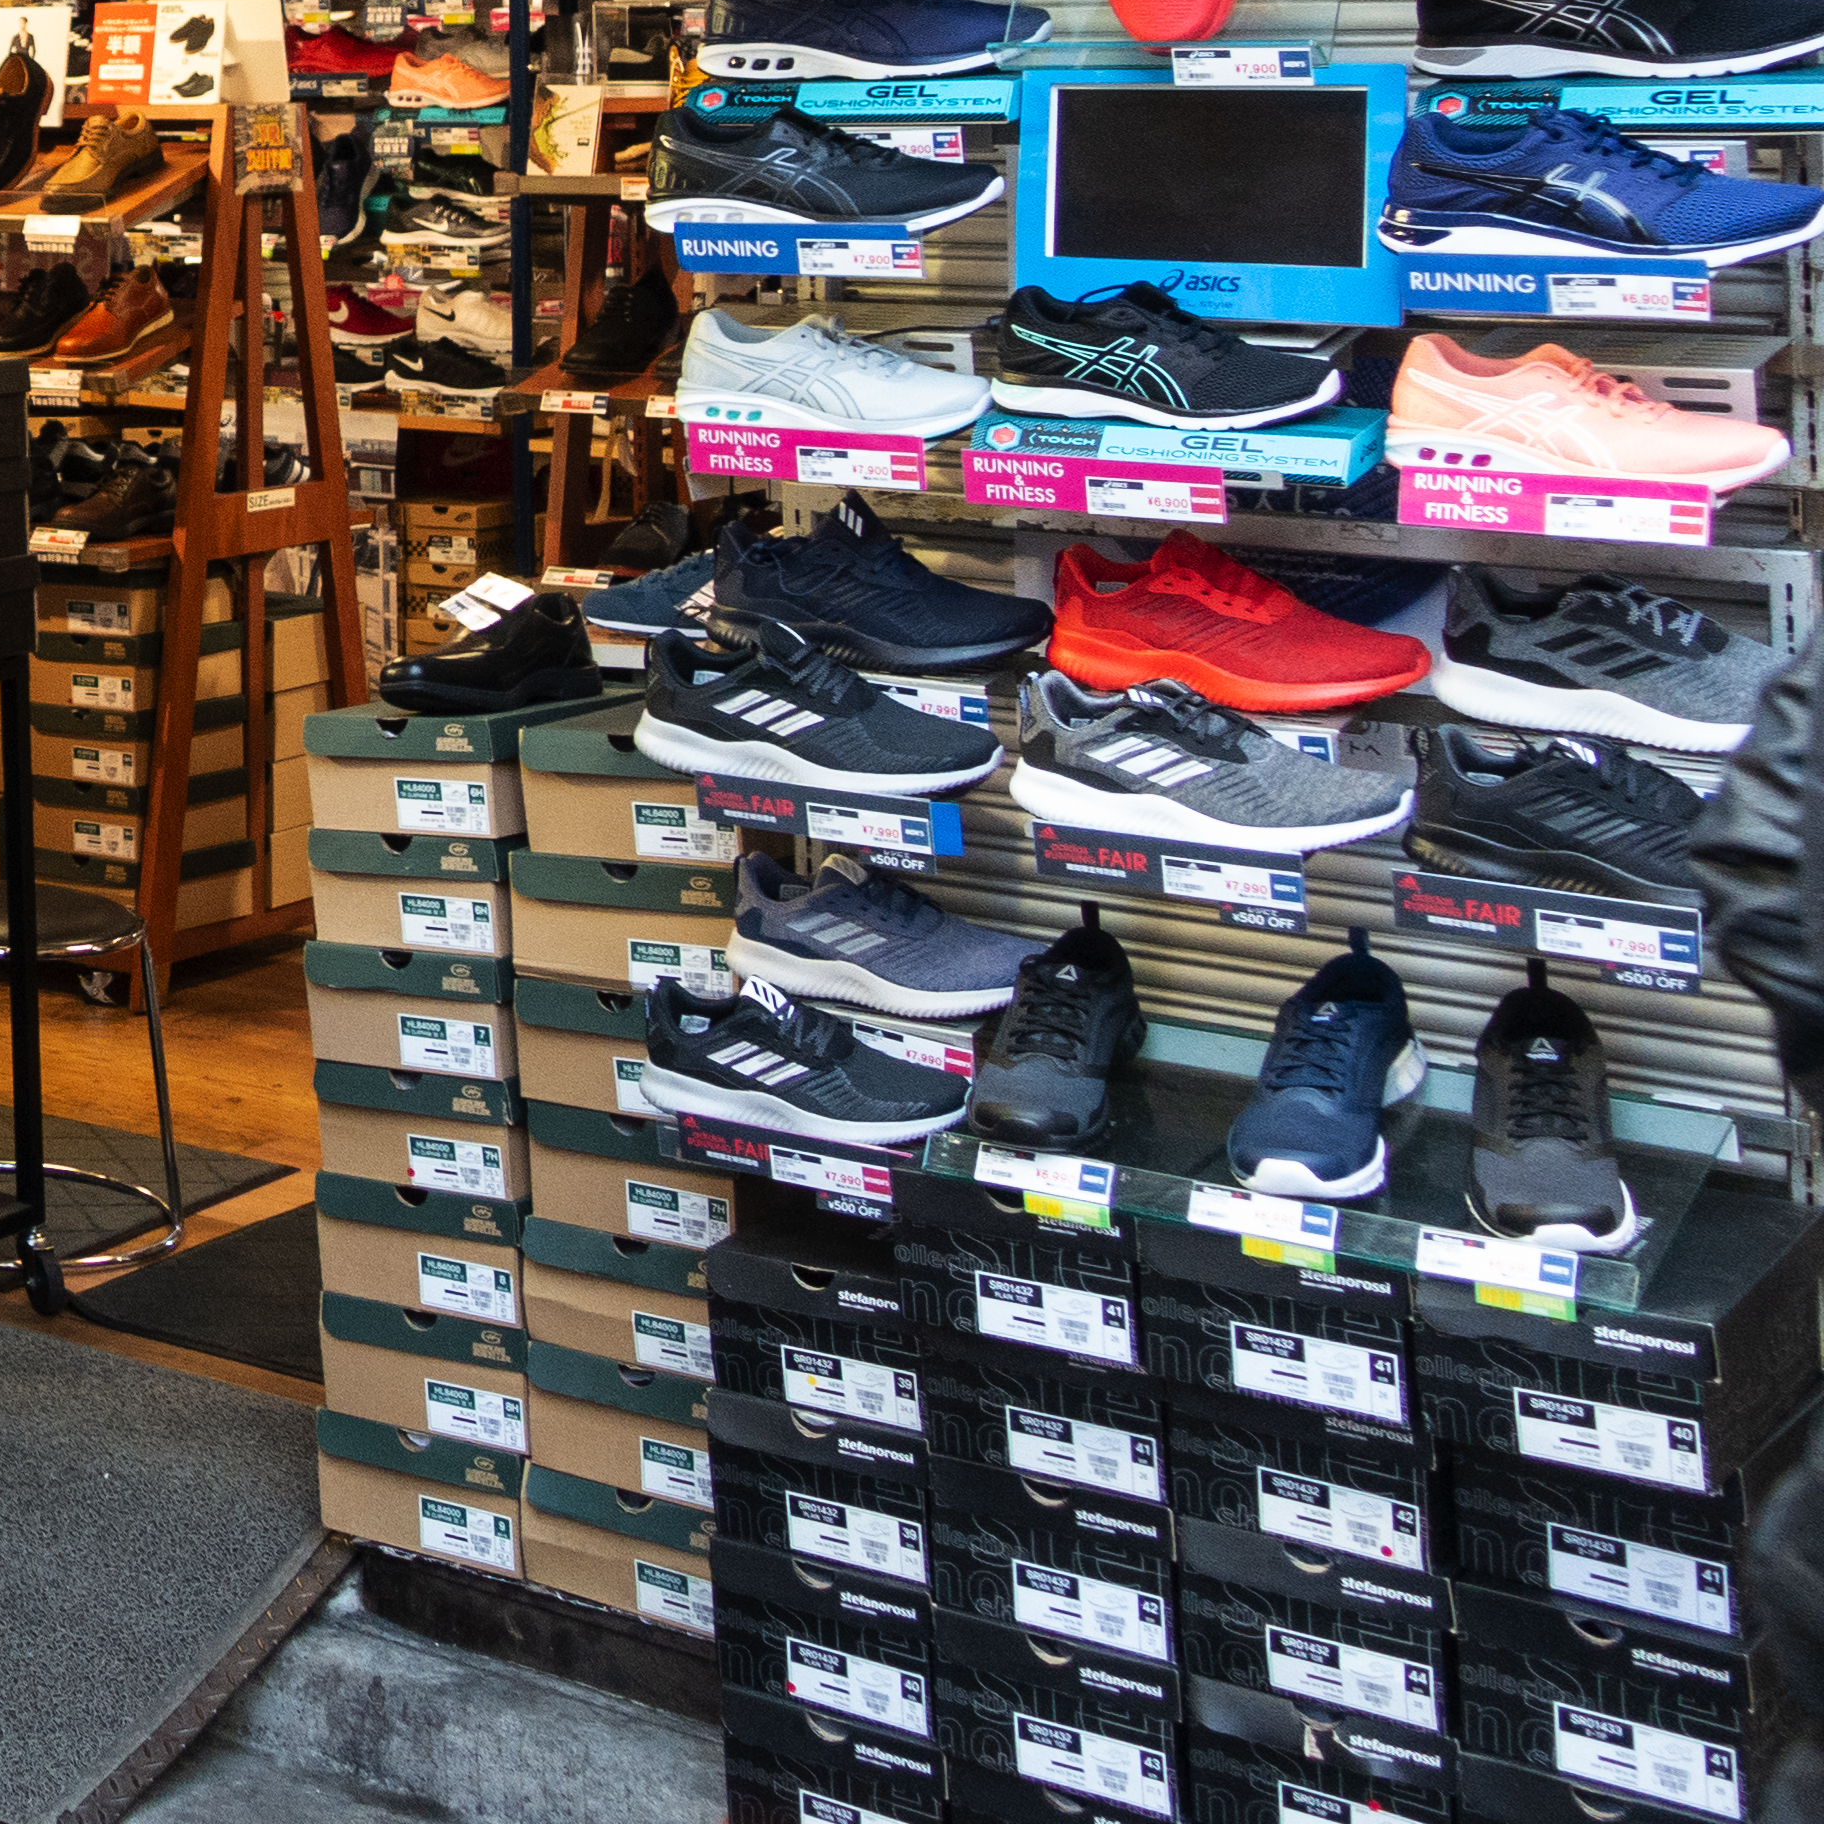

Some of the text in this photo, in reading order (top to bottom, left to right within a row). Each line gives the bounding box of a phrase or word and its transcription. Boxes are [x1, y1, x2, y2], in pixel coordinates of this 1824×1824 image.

[866, 84, 939, 99] GEL
[1650, 89, 1745, 106] GEL
[801, 96, 1002, 110] CUSHIONING SYSTEM
[682, 238, 779, 259] RUNNING
[1184, 271, 1240, 293] asics
[1409, 272, 1536, 294] RUNNING
[698, 430, 781, 448] RUNNING
[735, 446, 745, 457] &
[1254, 454, 1338, 468] SYSTEM
[709, 454, 773, 473] FITNESS
[973, 457, 1064, 478] RUNNING
[1013, 475, 1024, 486] &
[1414, 473, 1522, 495] RUNNING
[986, 485, 1056, 504] FITNESS
[1461, 493, 1474, 505] &
[1425, 503, 1509, 525] FITNESS
[752, 794, 795, 817] FAIR
[902, 858, 926, 871] OFF
[1098, 849, 1149, 872] FAIR
[1232, 912, 1296, 930] ¥500 OFF
[1465, 898, 1521, 927] FAIR
[1616, 971, 1689, 991] ¥500 OFF
[838, 1287, 899, 1312] stefanoro
[1594, 1322, 1697, 1357] stefanorossi
[897, 1375, 913, 1391] 39
[1672, 1425, 1694, 1443] 40
[838, 1436, 914, 1465] stefanorossi
[1135, 1441, 1152, 1456] 41
[1075, 1508, 1158, 1539] stefanorossi
[1026, 1571, 1071, 1590] SR01432
[1341, 1577, 1433, 1610] stefanorossi
[840, 1590, 917, 1620] stefanorossi
[1142, 1600, 1159, 1616] 42
[1280, 1634, 1330, 1657] SR01432
[1632, 1645, 1731, 1684] stefanorossi
[1079, 1666, 1163, 1699] stefanorossi
[1408, 1669, 1427, 1686] 44
[1570, 1711, 1624, 1736] SR01433
[855, 1742, 932, 1775] stefanorossi
[1350, 1733, 1441, 1769] stefanorossi
[1710, 1751, 1731, 1768] 41
